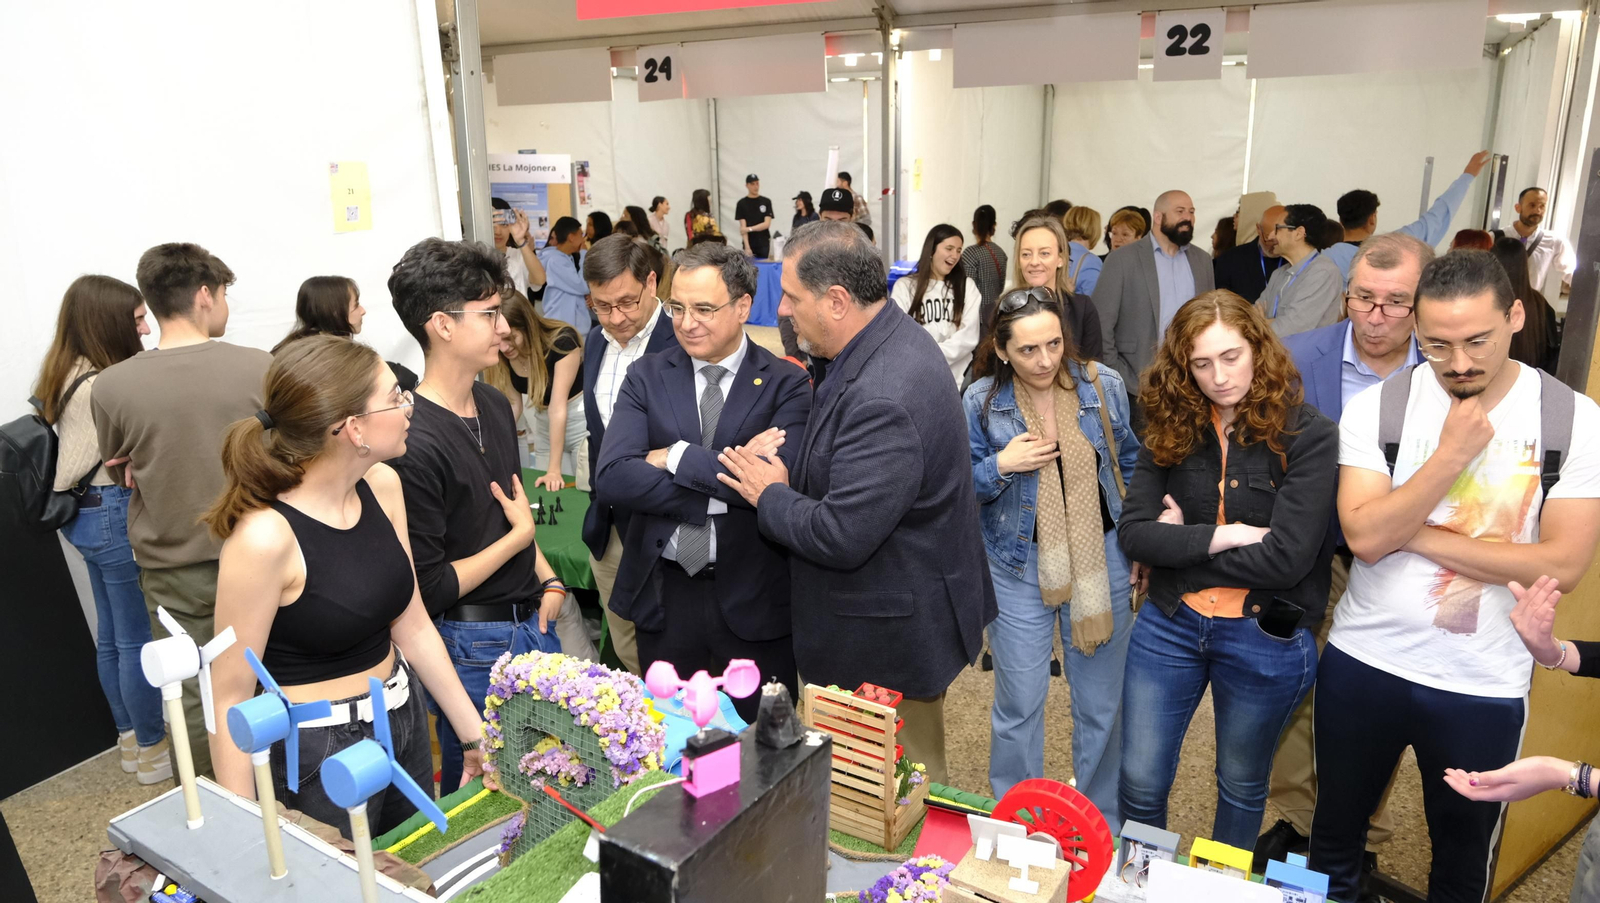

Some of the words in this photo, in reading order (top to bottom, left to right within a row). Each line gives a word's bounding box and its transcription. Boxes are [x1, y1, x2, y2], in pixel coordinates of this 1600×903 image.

[1165, 23, 1211, 56] 22
[644, 56, 672, 83] 24
[515, 164, 556, 173] Mojonera
